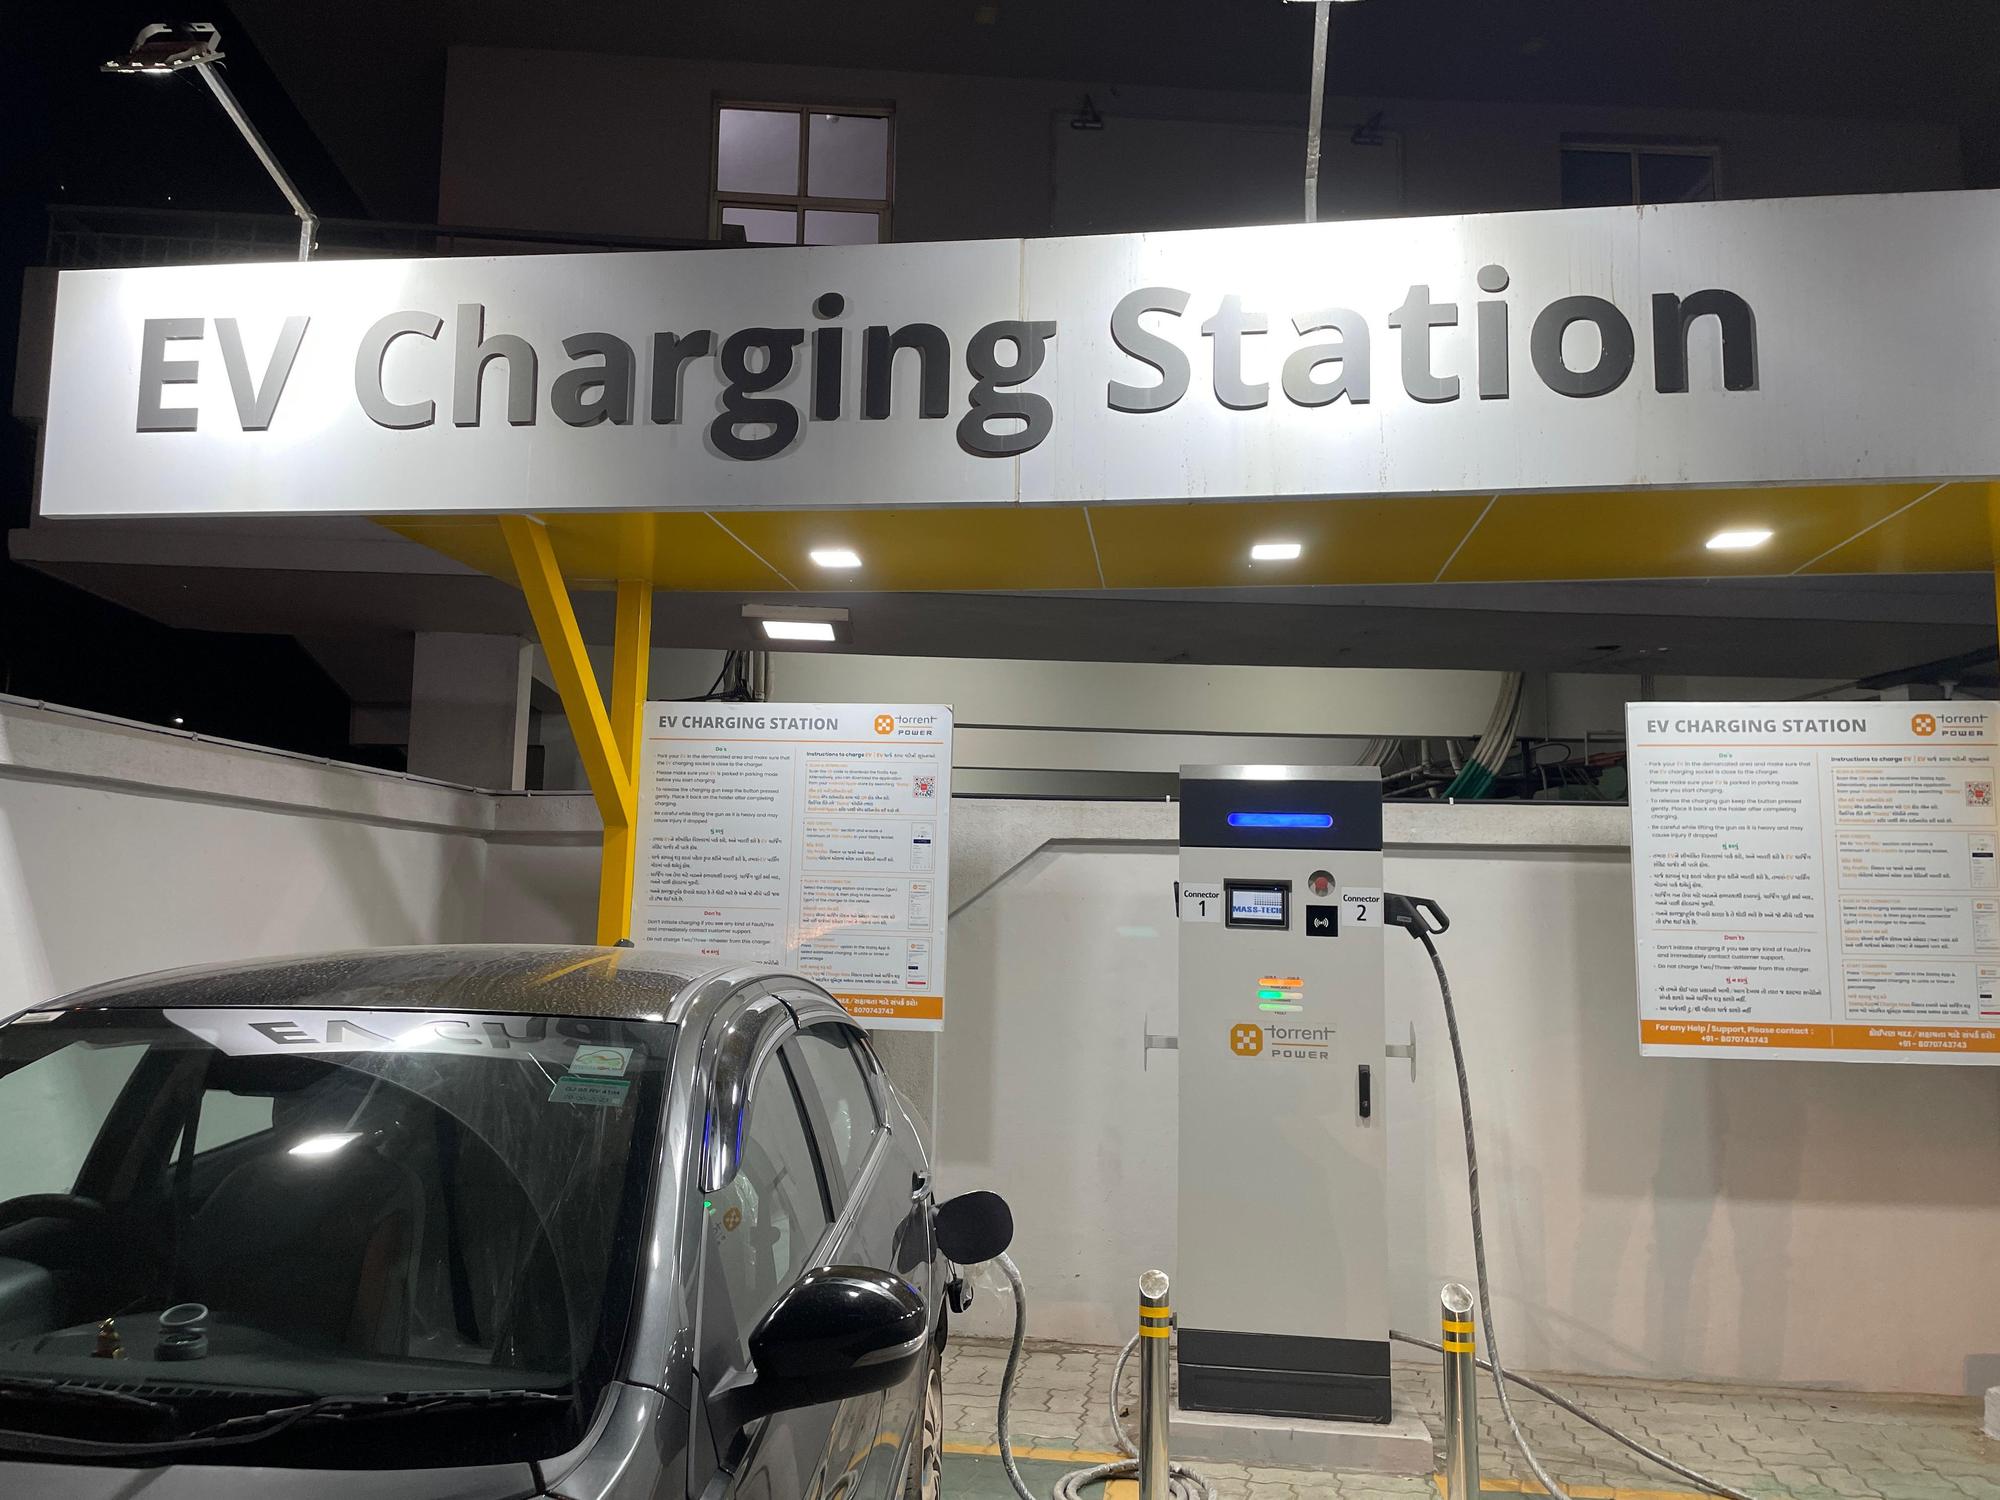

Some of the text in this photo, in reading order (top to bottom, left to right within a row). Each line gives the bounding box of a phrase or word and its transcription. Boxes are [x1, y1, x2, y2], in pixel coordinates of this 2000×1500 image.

[137, 264, 1757, 460] EV Charging Station
[659, 715, 839, 731] EV CHARGING STATION
[895, 715, 937, 724] torrent
[1936, 714, 1988, 724] torrent
[1647, 719, 1867, 734] EV CHARGING STATION
[845, 751, 864, 759] charge
[1879, 756, 1903, 764] charge
[1184, 890, 1220, 899] Connector
[1343, 894, 1380, 903] Connector
[1198, 900, 1206, 917] 1
[1356, 904, 1367, 921] 2
[1264, 1025, 1336, 1041] torrent
[1656, 1024, 1669, 1032] For
[1670, 1025, 1686, 1034] any
[1687, 1024, 1706, 1034] Help
[1748, 1026, 1774, 1034] Please
[1775, 1026, 1809, 1035] contact
[1272, 1049, 1329, 1060] POWER
